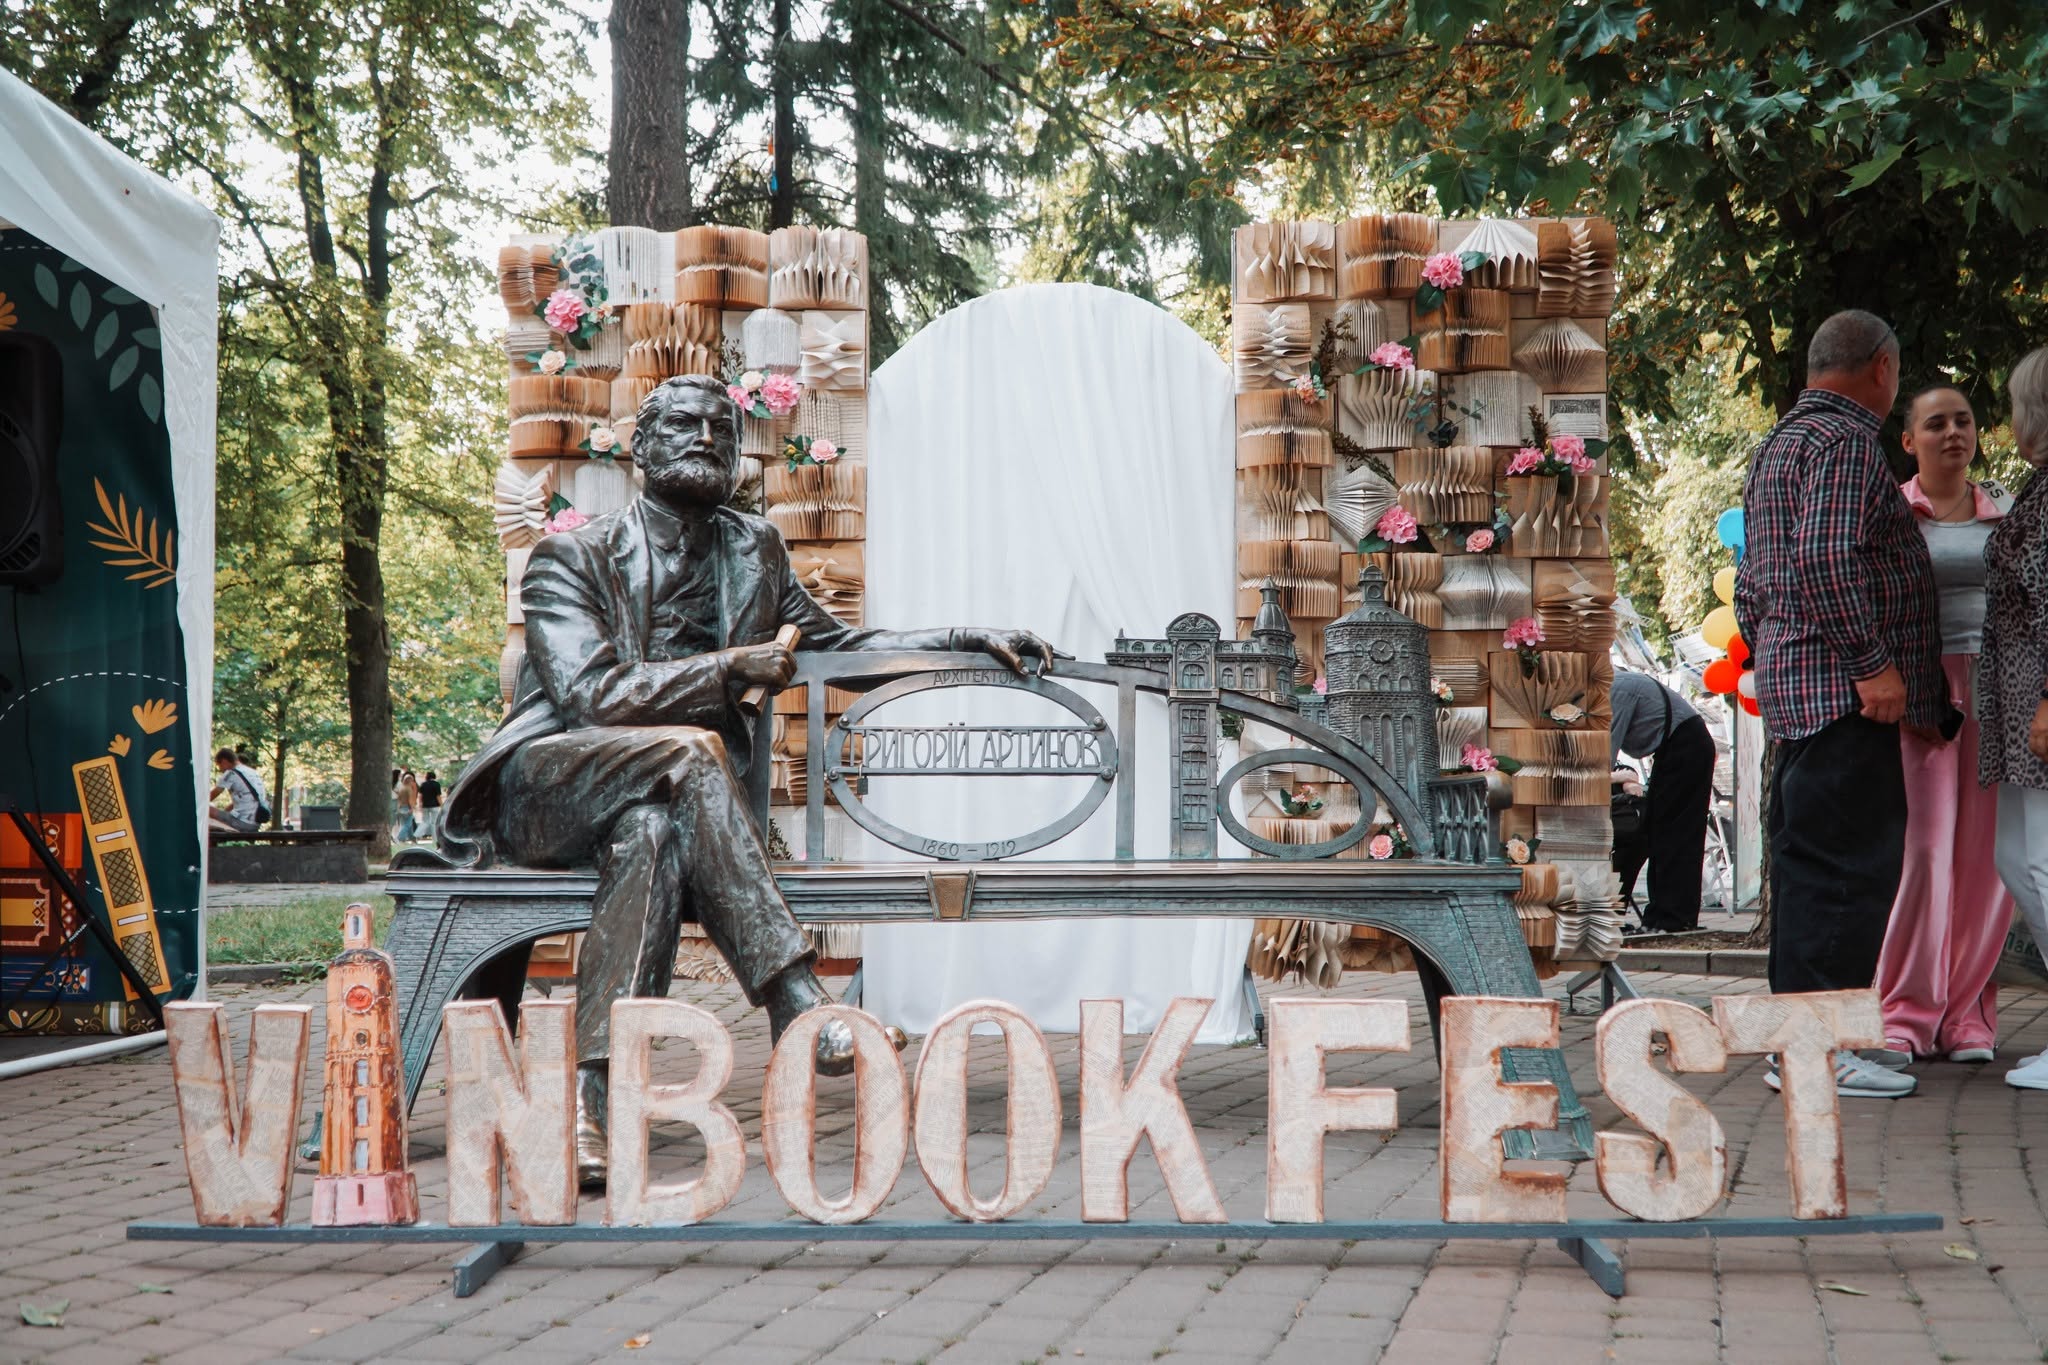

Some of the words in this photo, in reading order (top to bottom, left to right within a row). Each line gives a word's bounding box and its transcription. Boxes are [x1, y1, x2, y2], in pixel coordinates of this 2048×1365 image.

[850, 720, 970, 768] ГРИГОРІЙ
[979, 728, 1102, 768] АРТИНОВ
[920, 839, 960, 857] 1860
